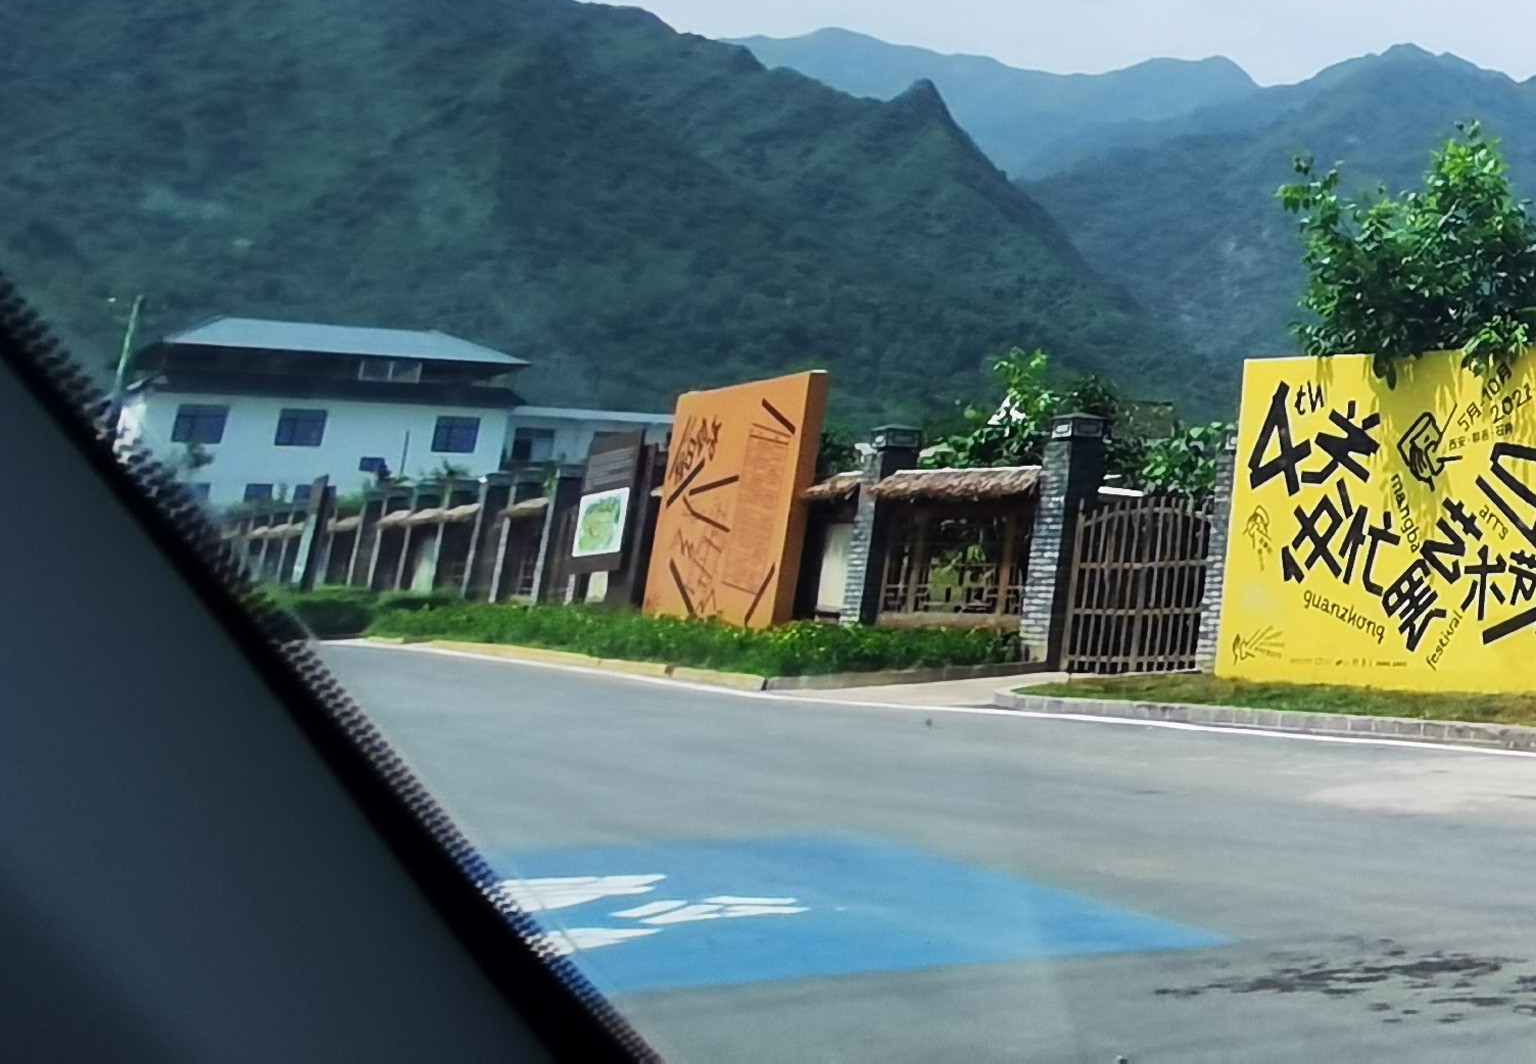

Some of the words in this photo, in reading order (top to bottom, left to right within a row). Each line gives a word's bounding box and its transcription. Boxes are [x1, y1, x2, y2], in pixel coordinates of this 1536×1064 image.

[1490, 382, 1532, 424] 2021
[1391, 473, 1420, 553] mangba
[1426, 609, 1463, 671] festival
